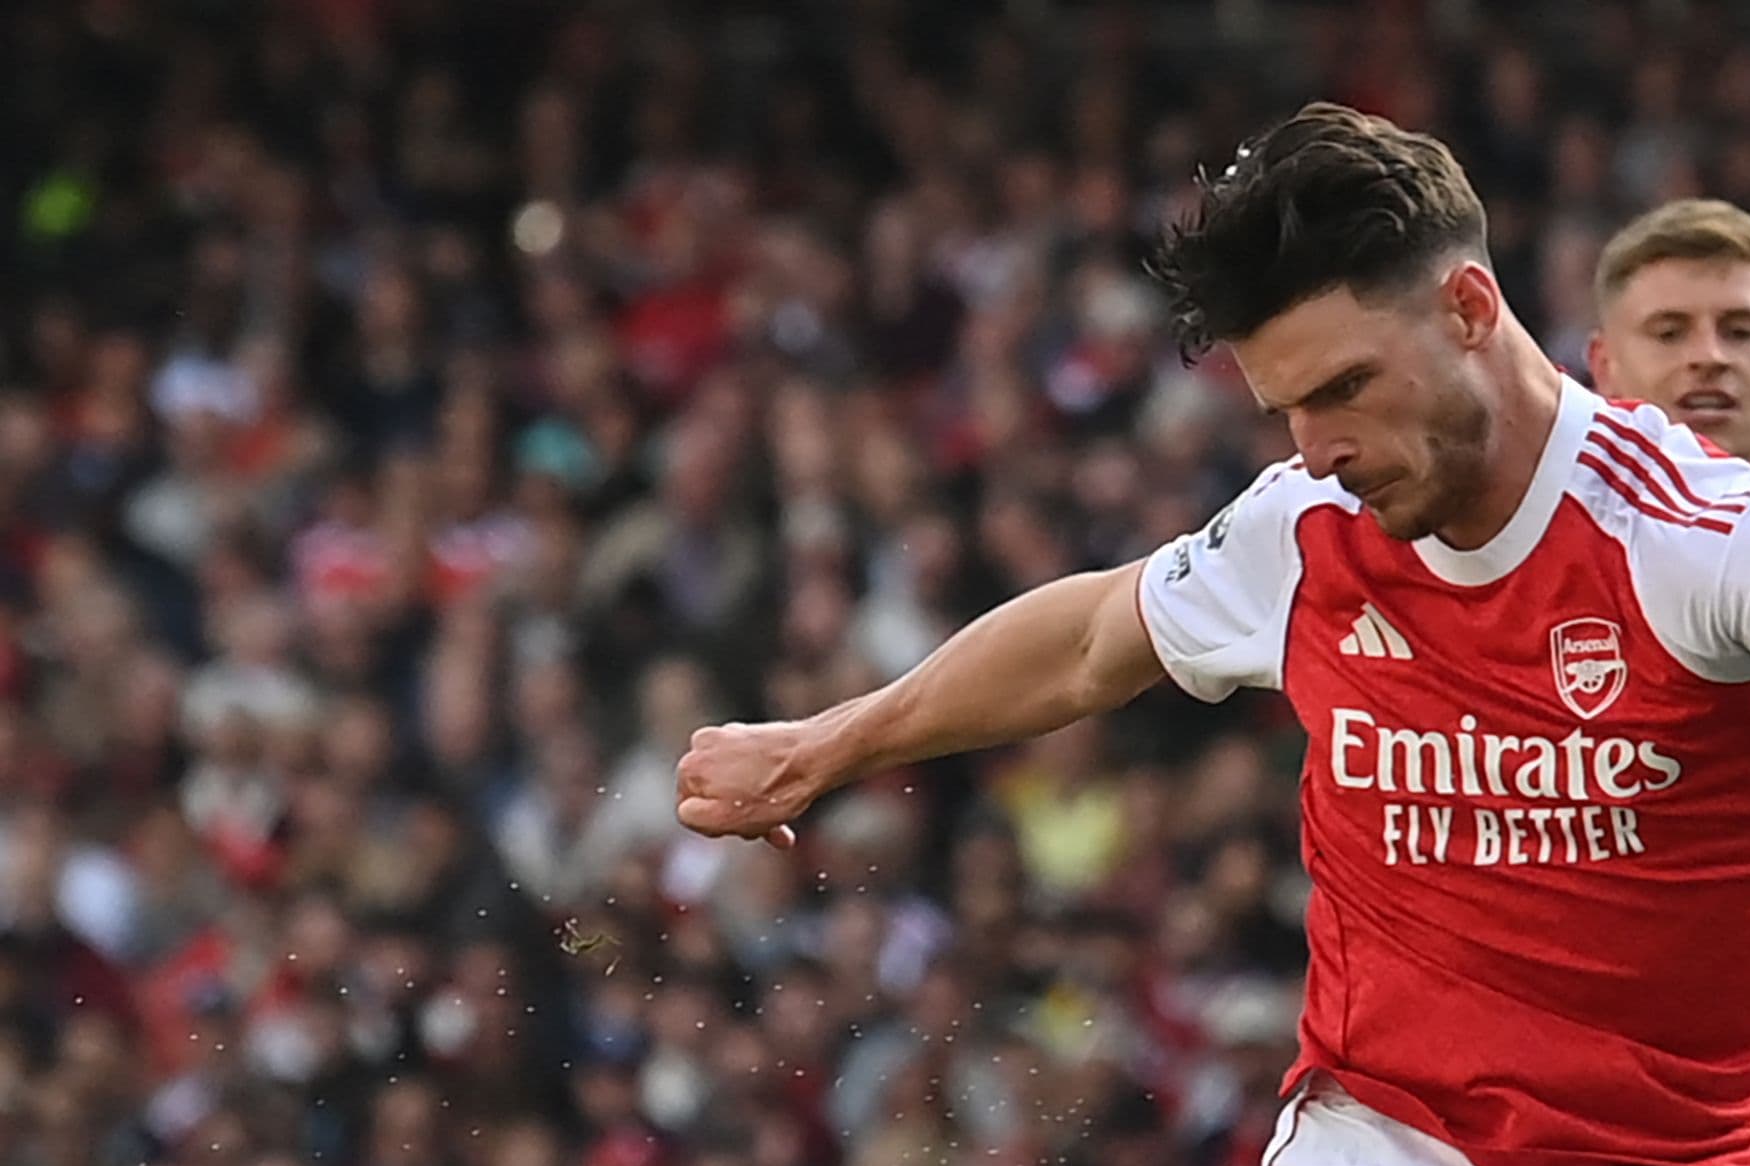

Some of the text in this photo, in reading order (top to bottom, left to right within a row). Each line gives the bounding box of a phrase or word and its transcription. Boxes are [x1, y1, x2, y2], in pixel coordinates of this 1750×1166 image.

[1331, 708, 1682, 800] Emirates
[1383, 804, 1645, 866] FLY BETTER
